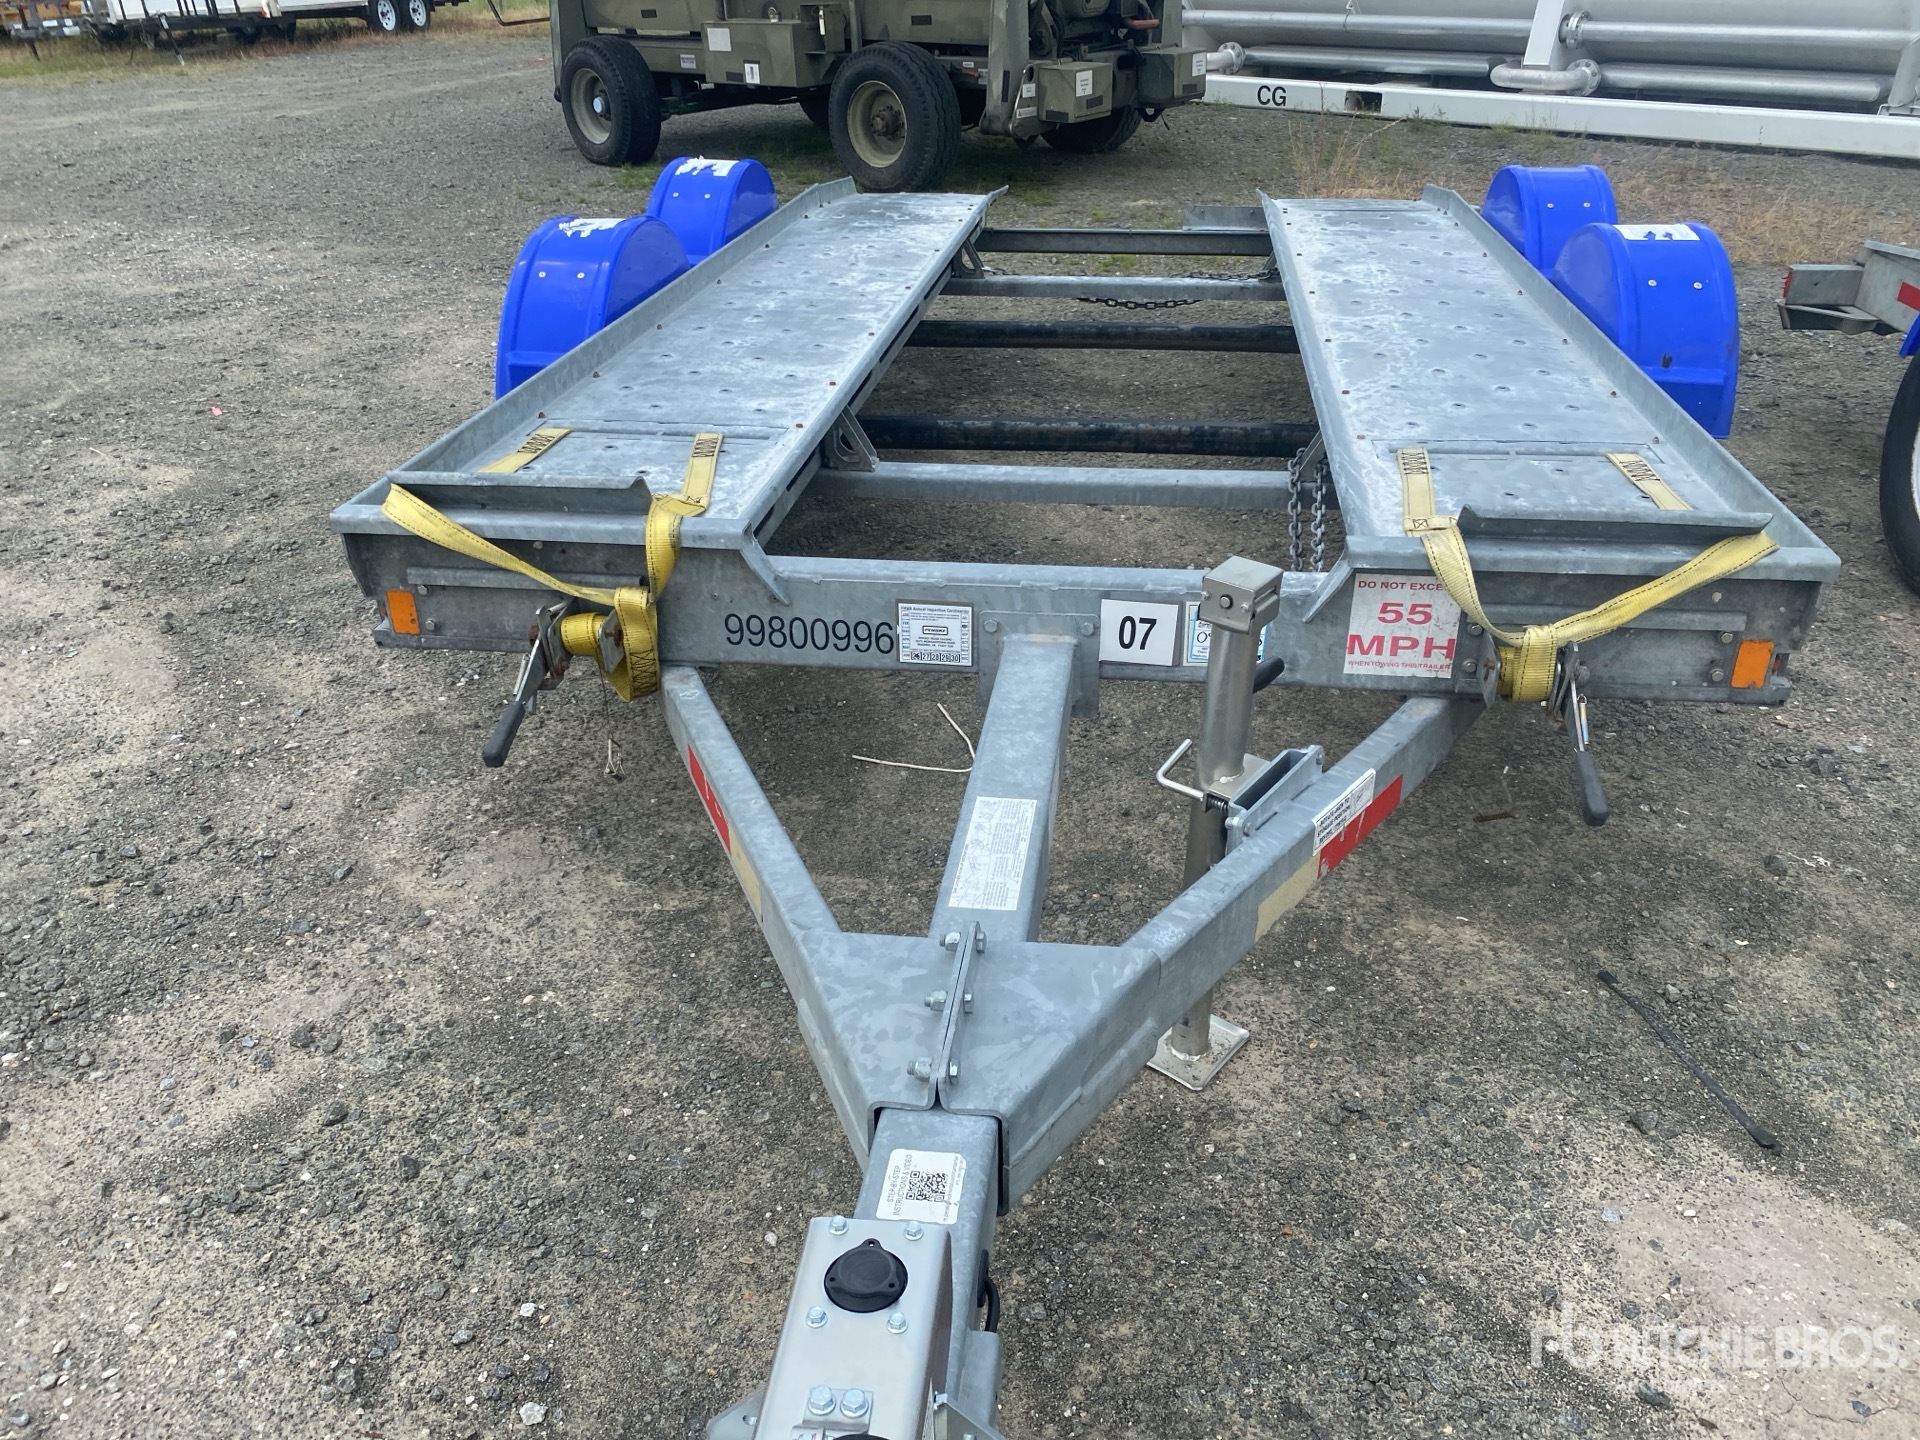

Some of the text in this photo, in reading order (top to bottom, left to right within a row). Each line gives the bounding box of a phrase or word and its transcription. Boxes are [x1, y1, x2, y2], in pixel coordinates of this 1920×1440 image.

[1256, 85, 1287, 107] CG
[1358, 580, 1444, 591] DO NOT EXCE
[1377, 602, 1433, 625] 55
[725, 613, 895, 655] 99800996
[1118, 615, 1156, 650] 07
[922, 652, 929, 660] 27
[931, 653, 939, 661] 28
[950, 654, 958, 662] 30
[1347, 634, 1456, 660] MPH
[1371, 661, 1399, 669] TOWING
[886, 1165, 901, 1203] STEP-BY-STEP
[893, 1174, 908, 1216] INSTRUCTIONS
[905, 1154, 913, 1171] VIDEO
